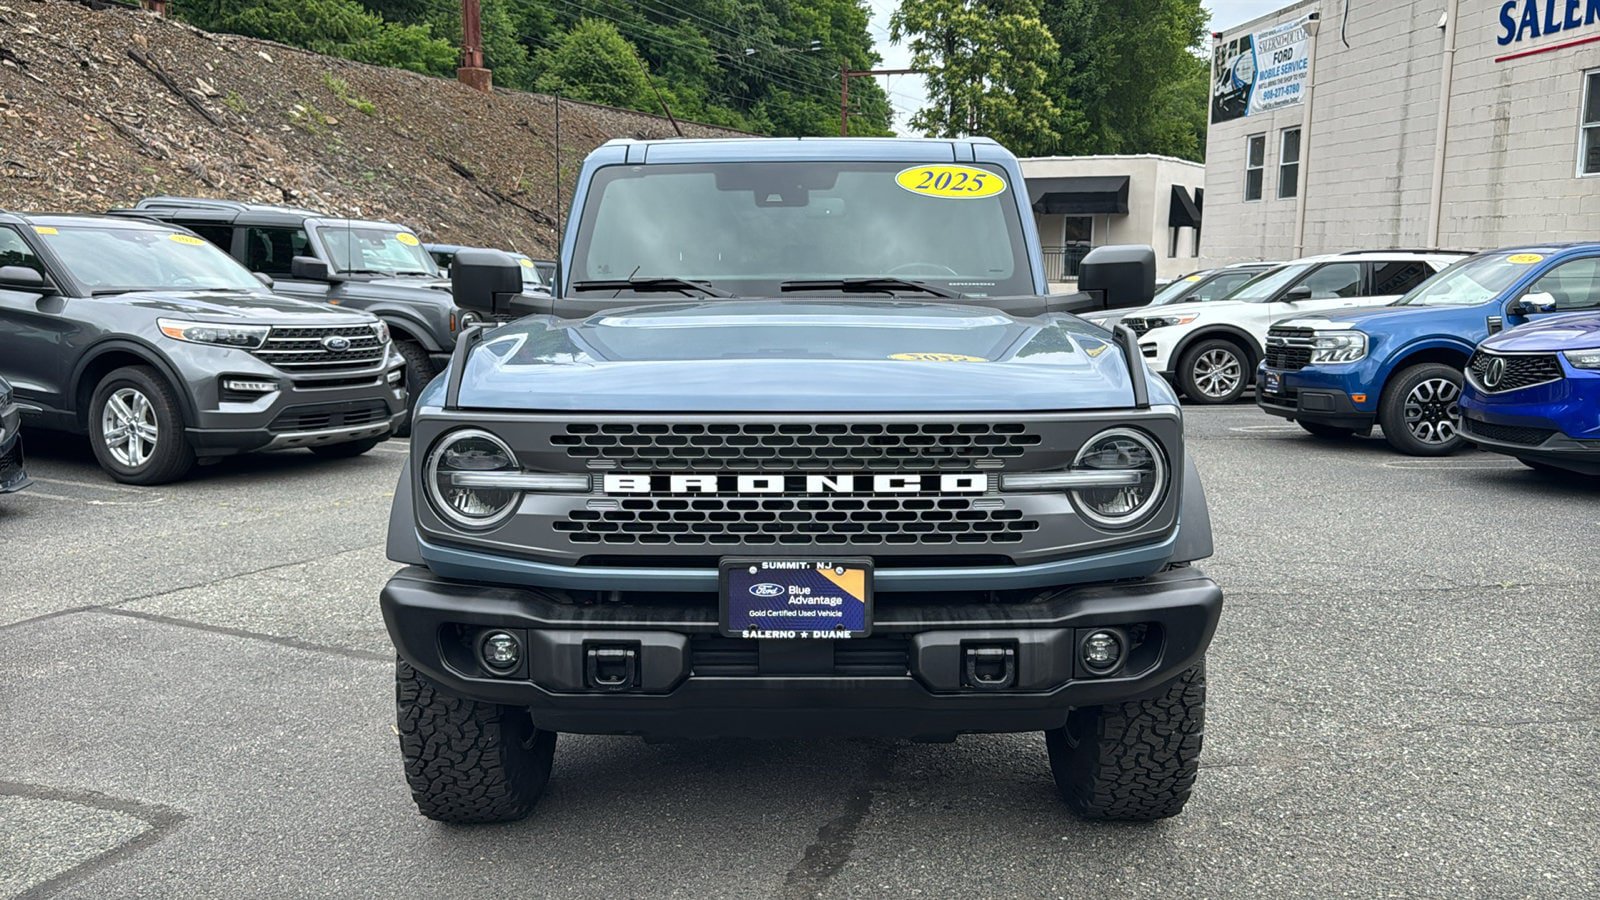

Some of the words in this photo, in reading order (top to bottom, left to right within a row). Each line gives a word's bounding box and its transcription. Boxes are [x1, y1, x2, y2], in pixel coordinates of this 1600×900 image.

[1273, 47, 1293, 65] FORD
[1259, 66, 1280, 81] MOBILE
[1281, 58, 1308, 74] SERVICE
[916, 171, 986, 191] 2025
[603, 474, 988, 493] BRONCO
[816, 561, 832, 569] NJ
[755, 584, 779, 594] Ford
[788, 585, 811, 595] Blue
[788, 595, 843, 607] Advantage
[742, 630, 796, 639] SALERNO
[813, 630, 852, 639] DUANE
